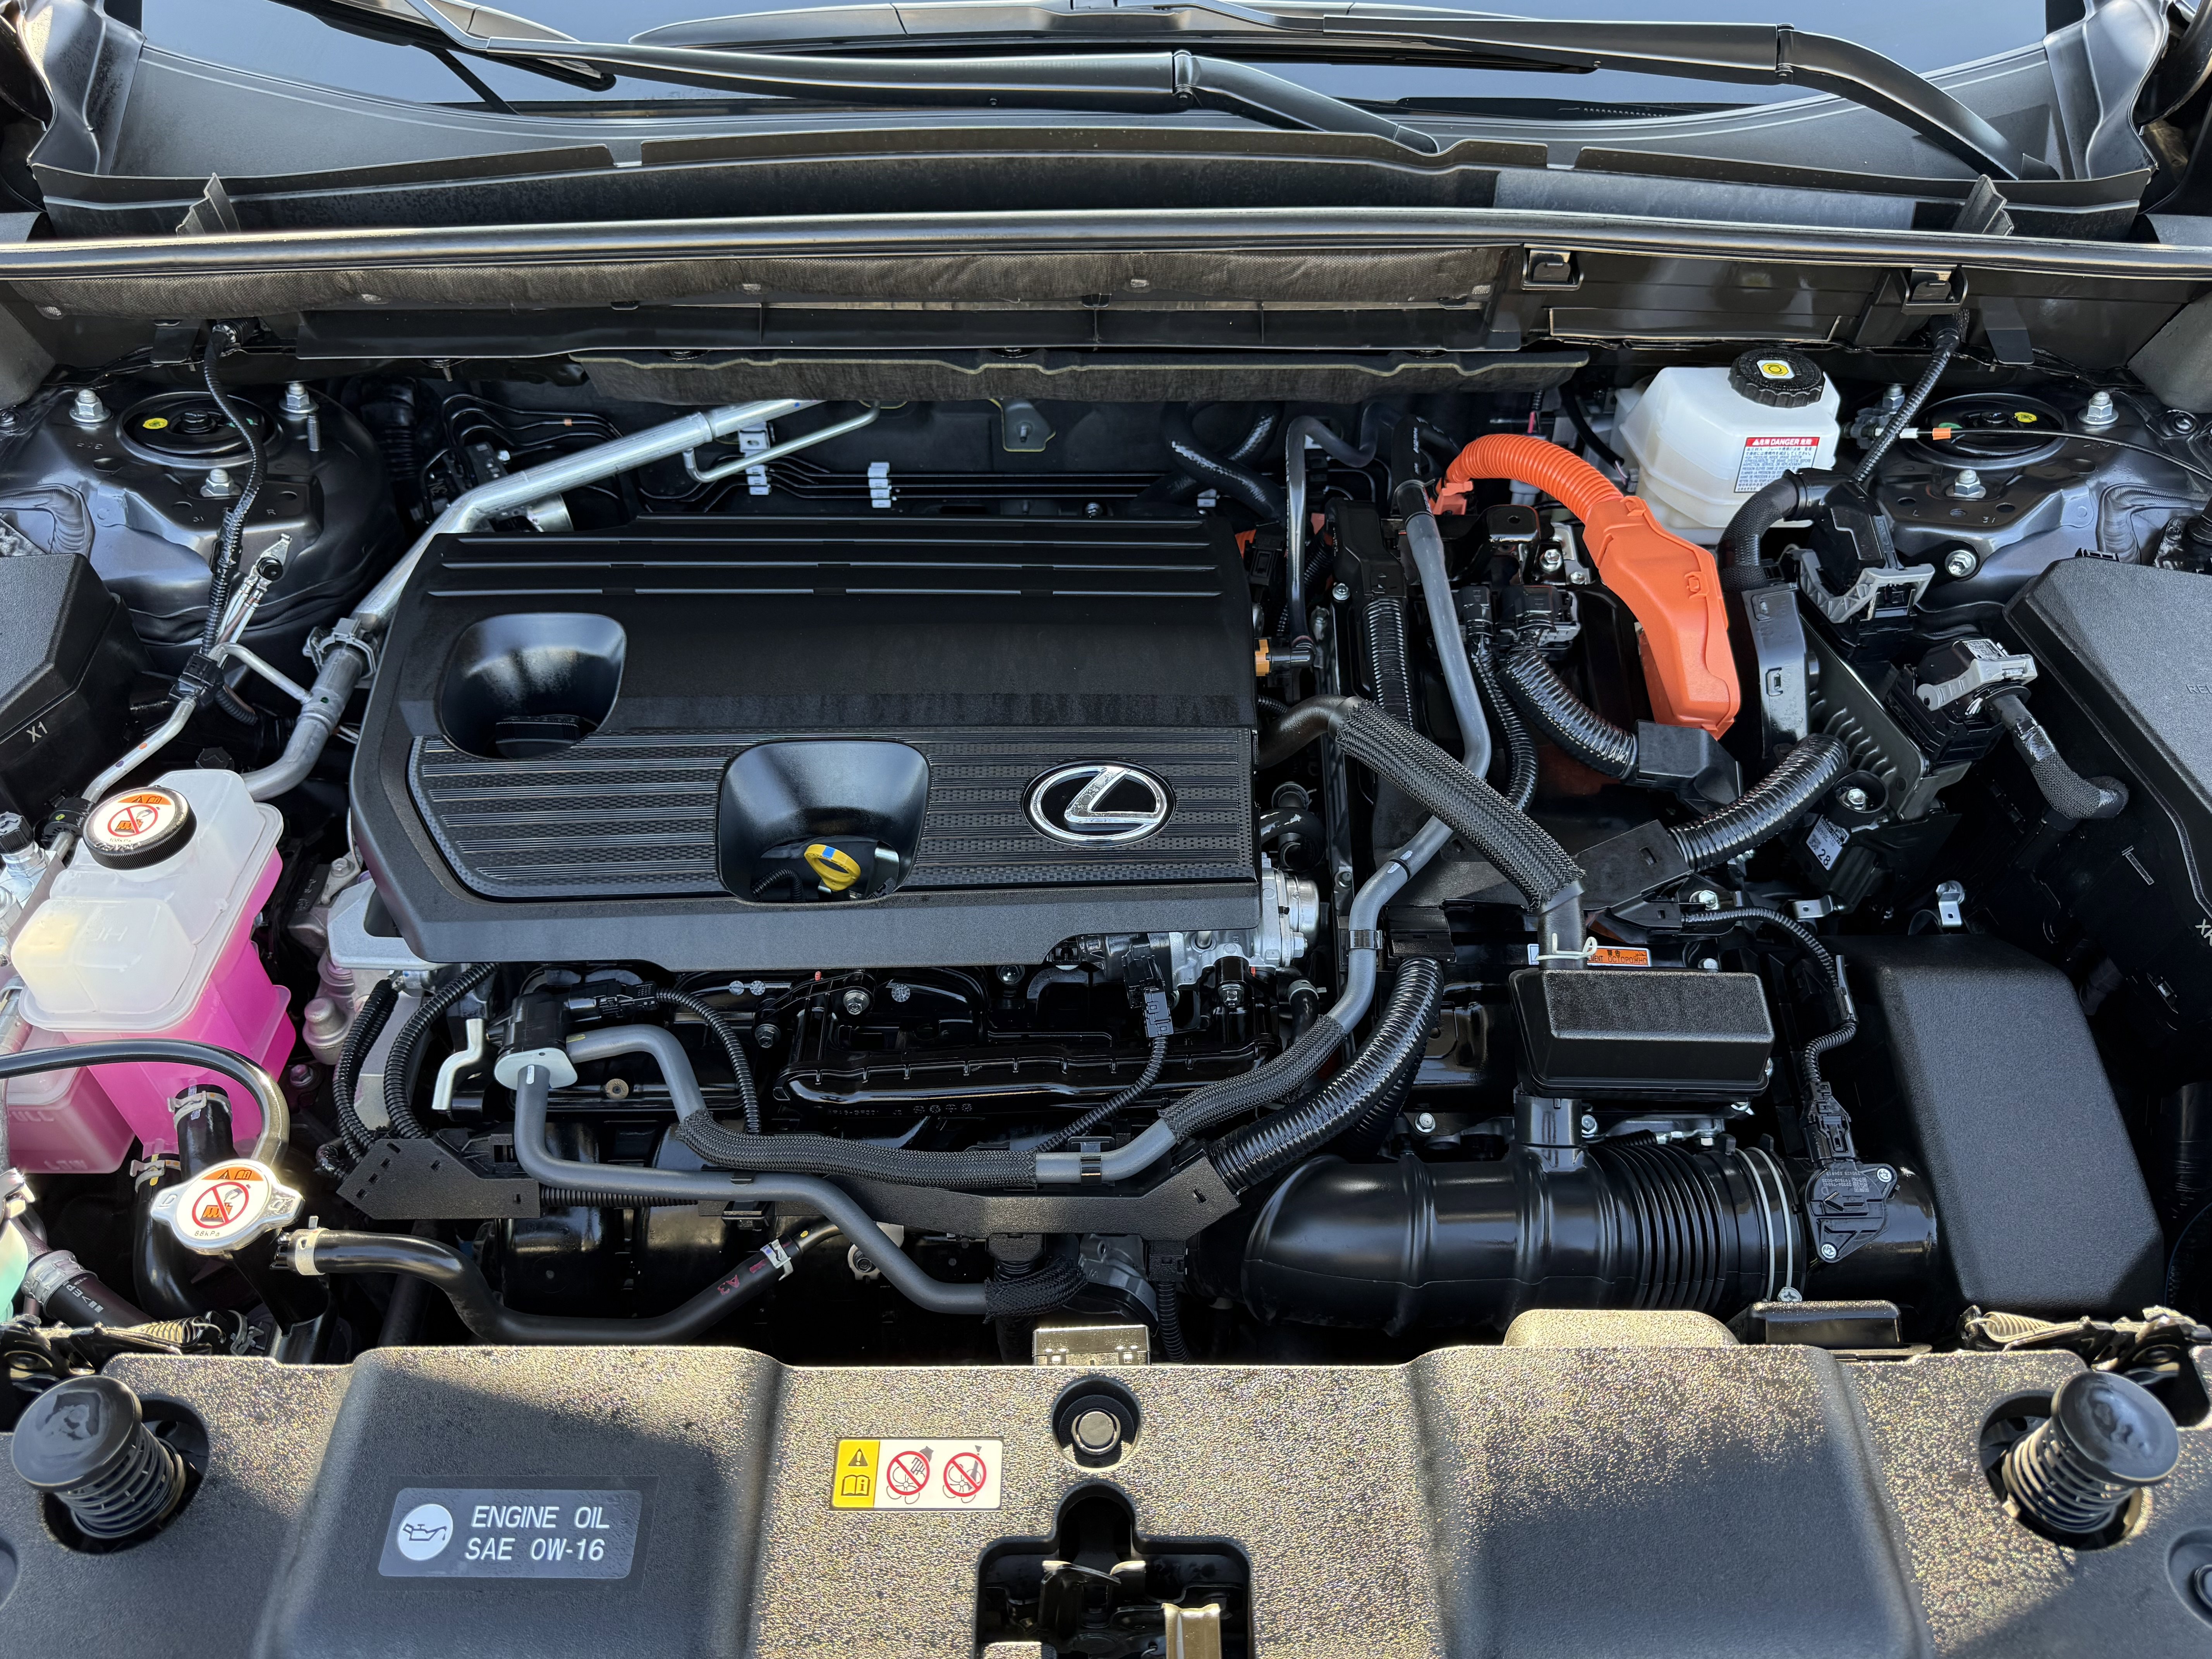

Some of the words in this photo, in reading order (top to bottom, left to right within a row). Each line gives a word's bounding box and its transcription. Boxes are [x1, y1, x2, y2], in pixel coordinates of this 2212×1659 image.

[26, 721, 48, 743] X1
[1817, 848, 1831, 866] 28
[1608, 956, 1648, 964] ОСТОРОЖНО
[44, 1159, 88, 1170] LOW
[717, 1274, 740, 1295] A3
[471, 1506, 560, 1528] ENGINE
[574, 1506, 610, 1529] OIL
[464, 1538, 515, 1561] SAE
[529, 1538, 605, 1561] 0W-16
